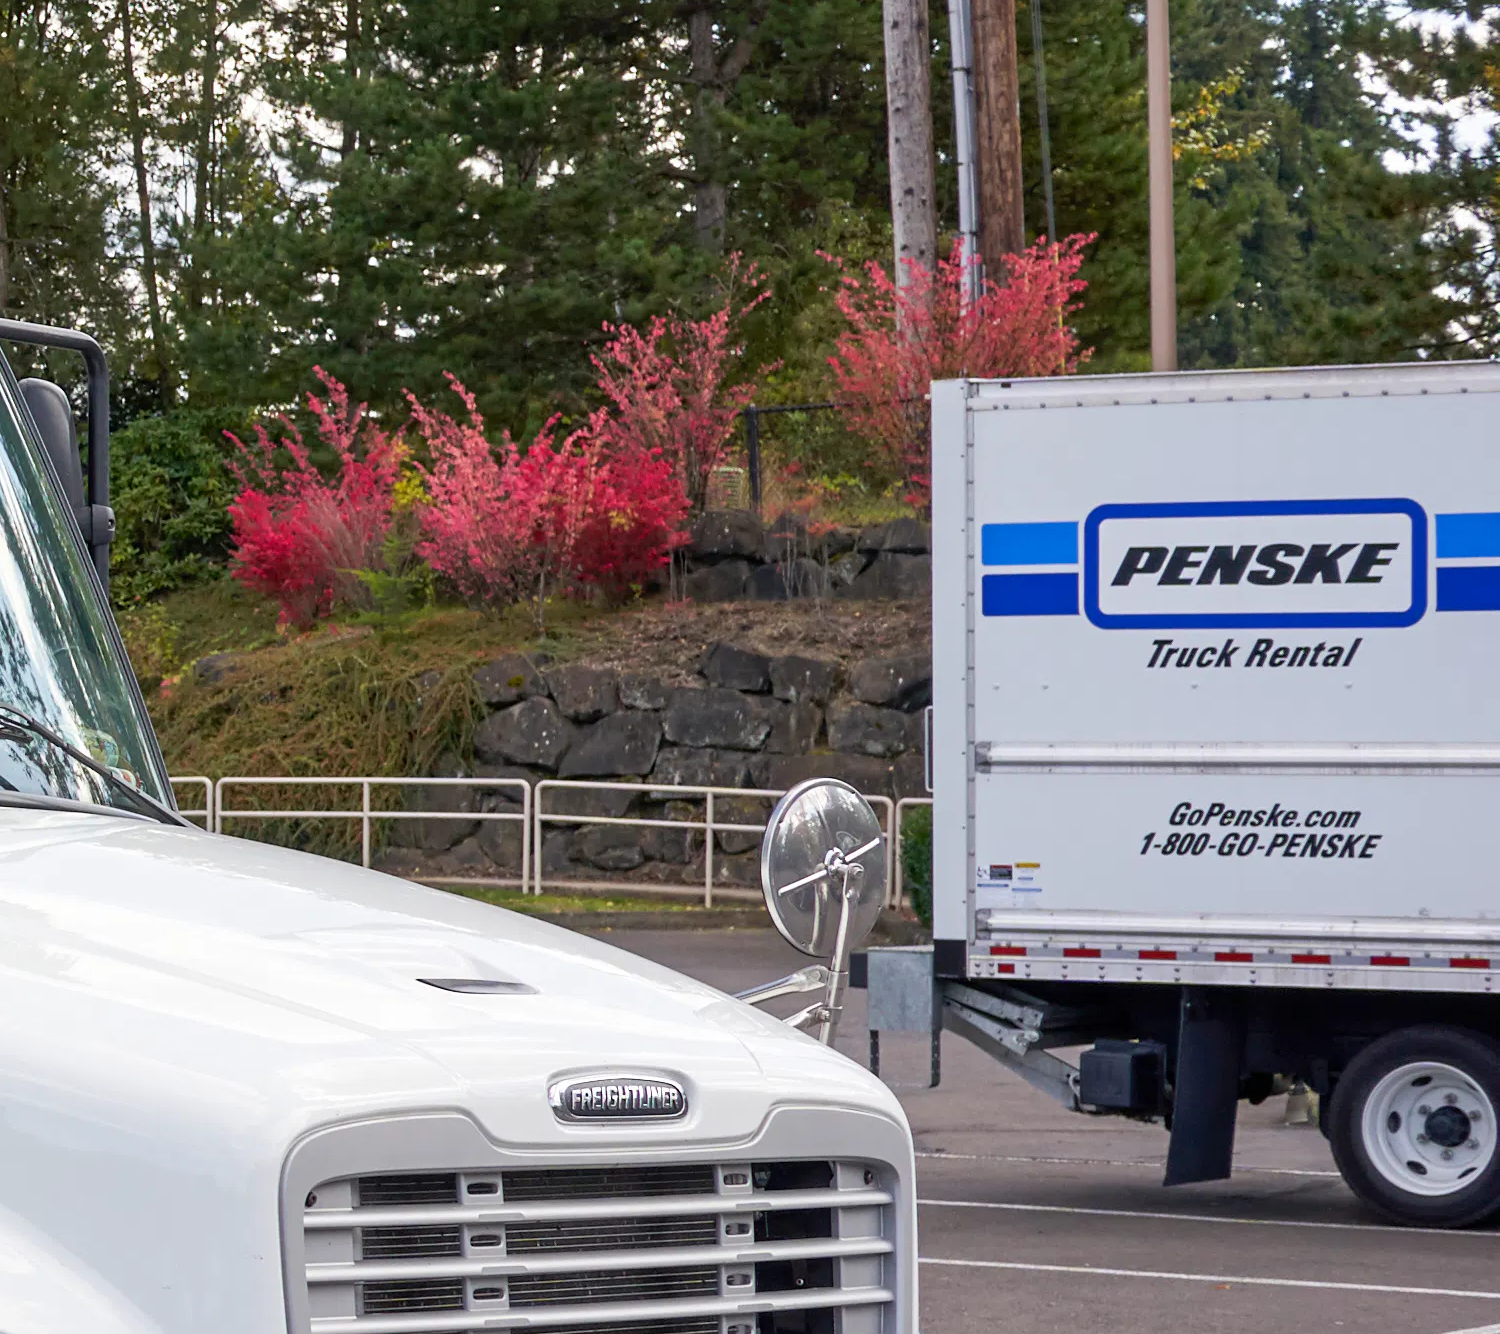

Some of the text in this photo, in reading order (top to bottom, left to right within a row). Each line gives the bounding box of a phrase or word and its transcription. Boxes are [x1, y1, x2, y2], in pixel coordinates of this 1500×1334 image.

[1110, 543, 1400, 586] PENSKE
[1147, 638, 1362, 668] Truck Rental
[1168, 802, 1361, 828] GoPenske.com
[1140, 832, 1383, 859] 1-800-GO-PENSKE
[571, 1085, 679, 1110] FREIGHTLINER
